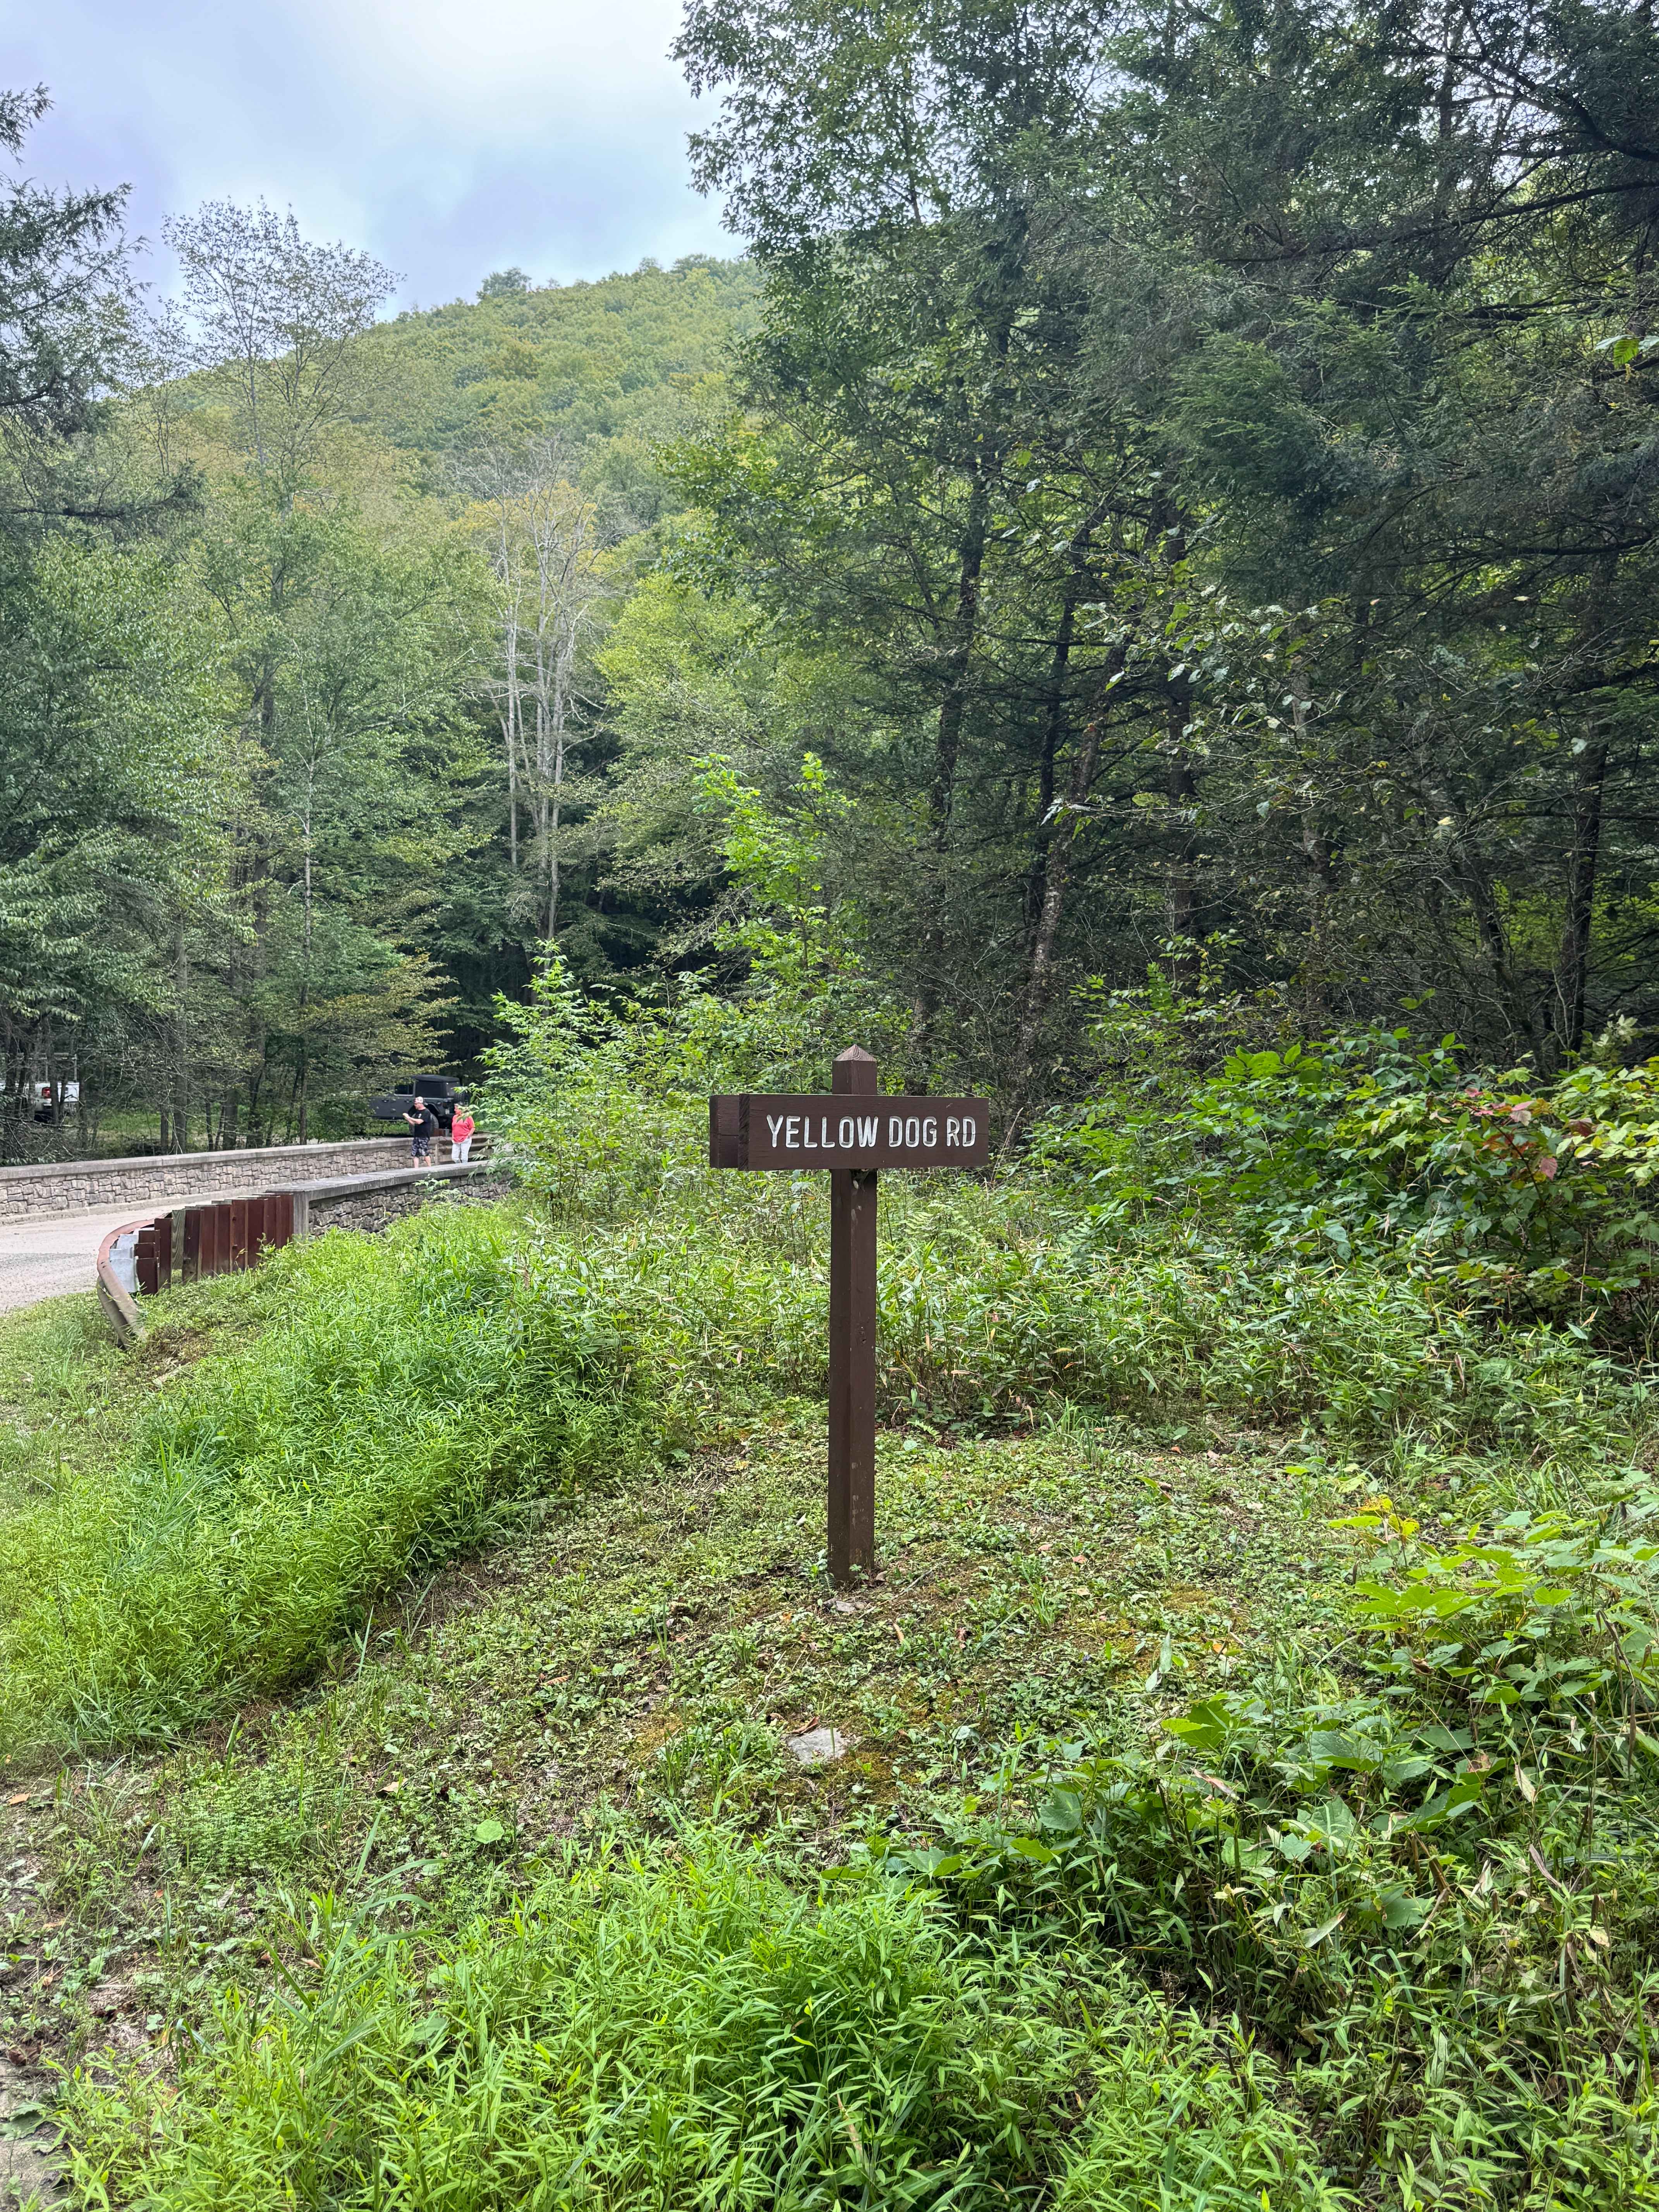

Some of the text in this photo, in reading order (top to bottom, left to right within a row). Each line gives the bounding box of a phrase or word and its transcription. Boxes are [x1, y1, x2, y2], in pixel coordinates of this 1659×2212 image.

[766, 1115, 976, 1148] YELLOW DOG RD
